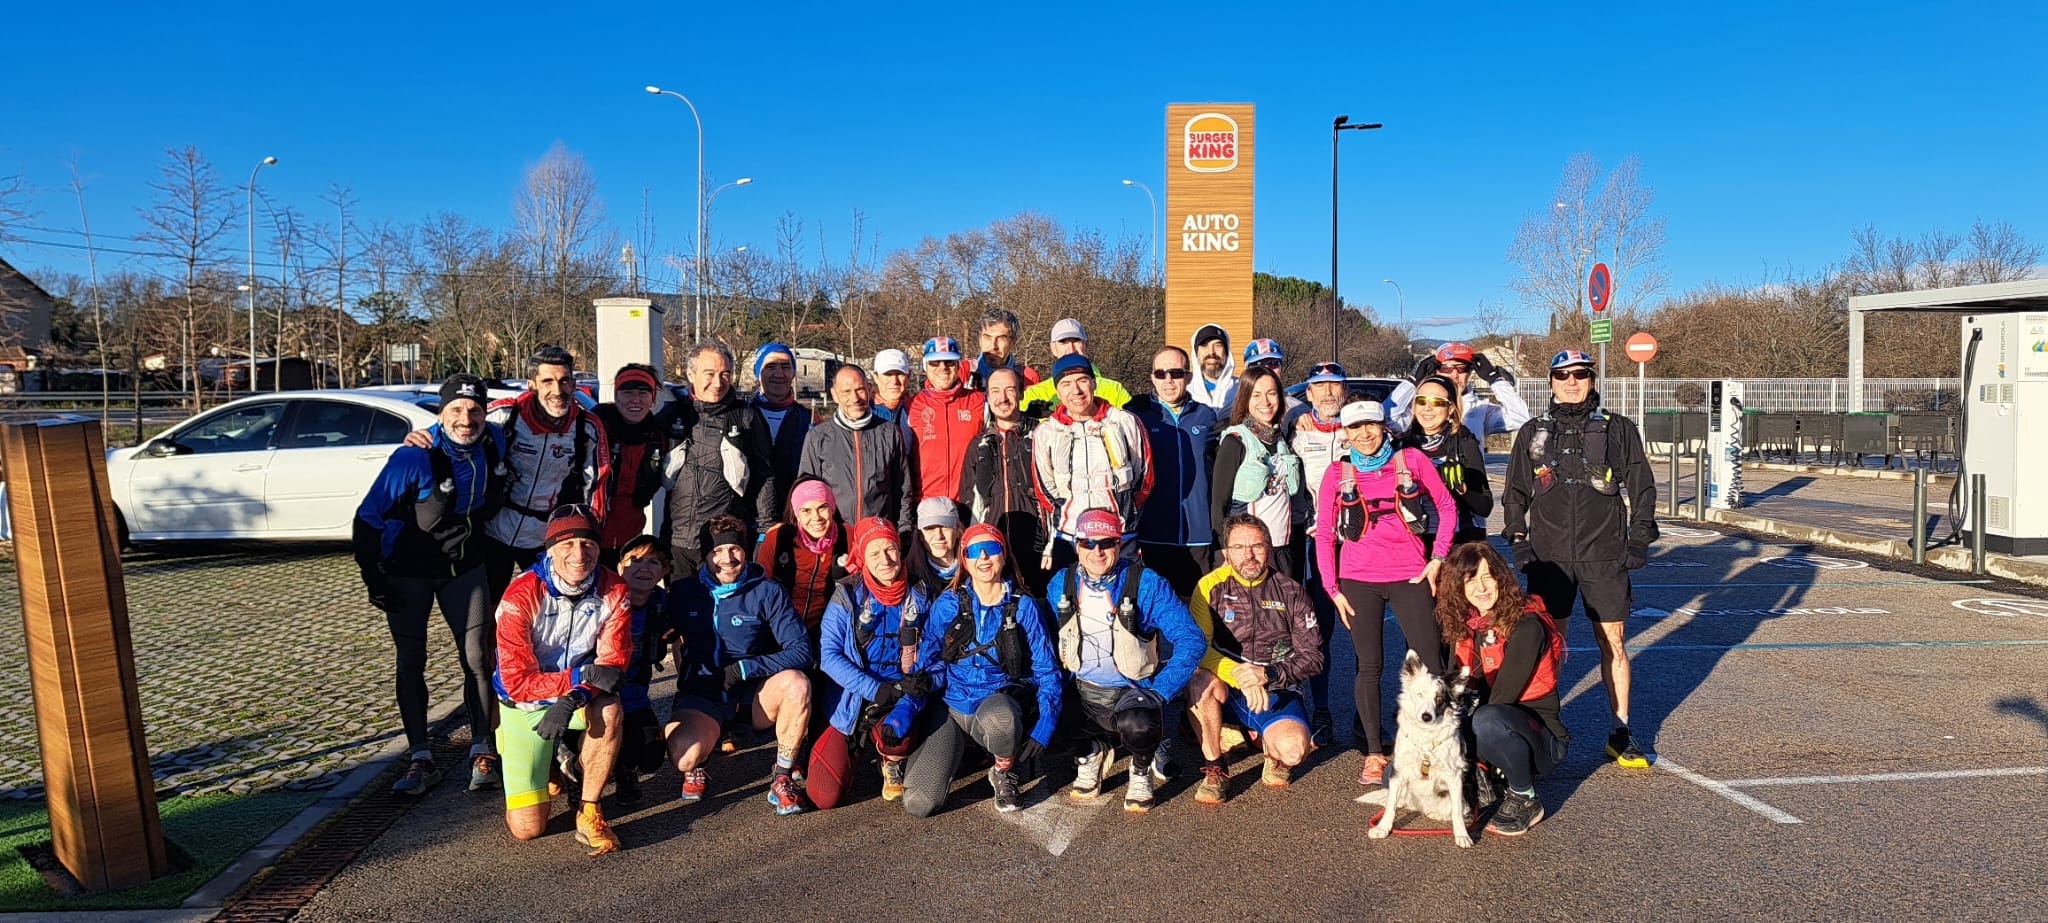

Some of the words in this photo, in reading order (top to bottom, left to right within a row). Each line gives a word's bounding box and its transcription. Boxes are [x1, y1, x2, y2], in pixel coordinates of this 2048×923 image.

[1189, 133, 1234, 143] BURGER
[1189, 144, 1235, 159] KING
[1182, 214, 1239, 231] AUTO
[1182, 232, 1239, 252] KING
